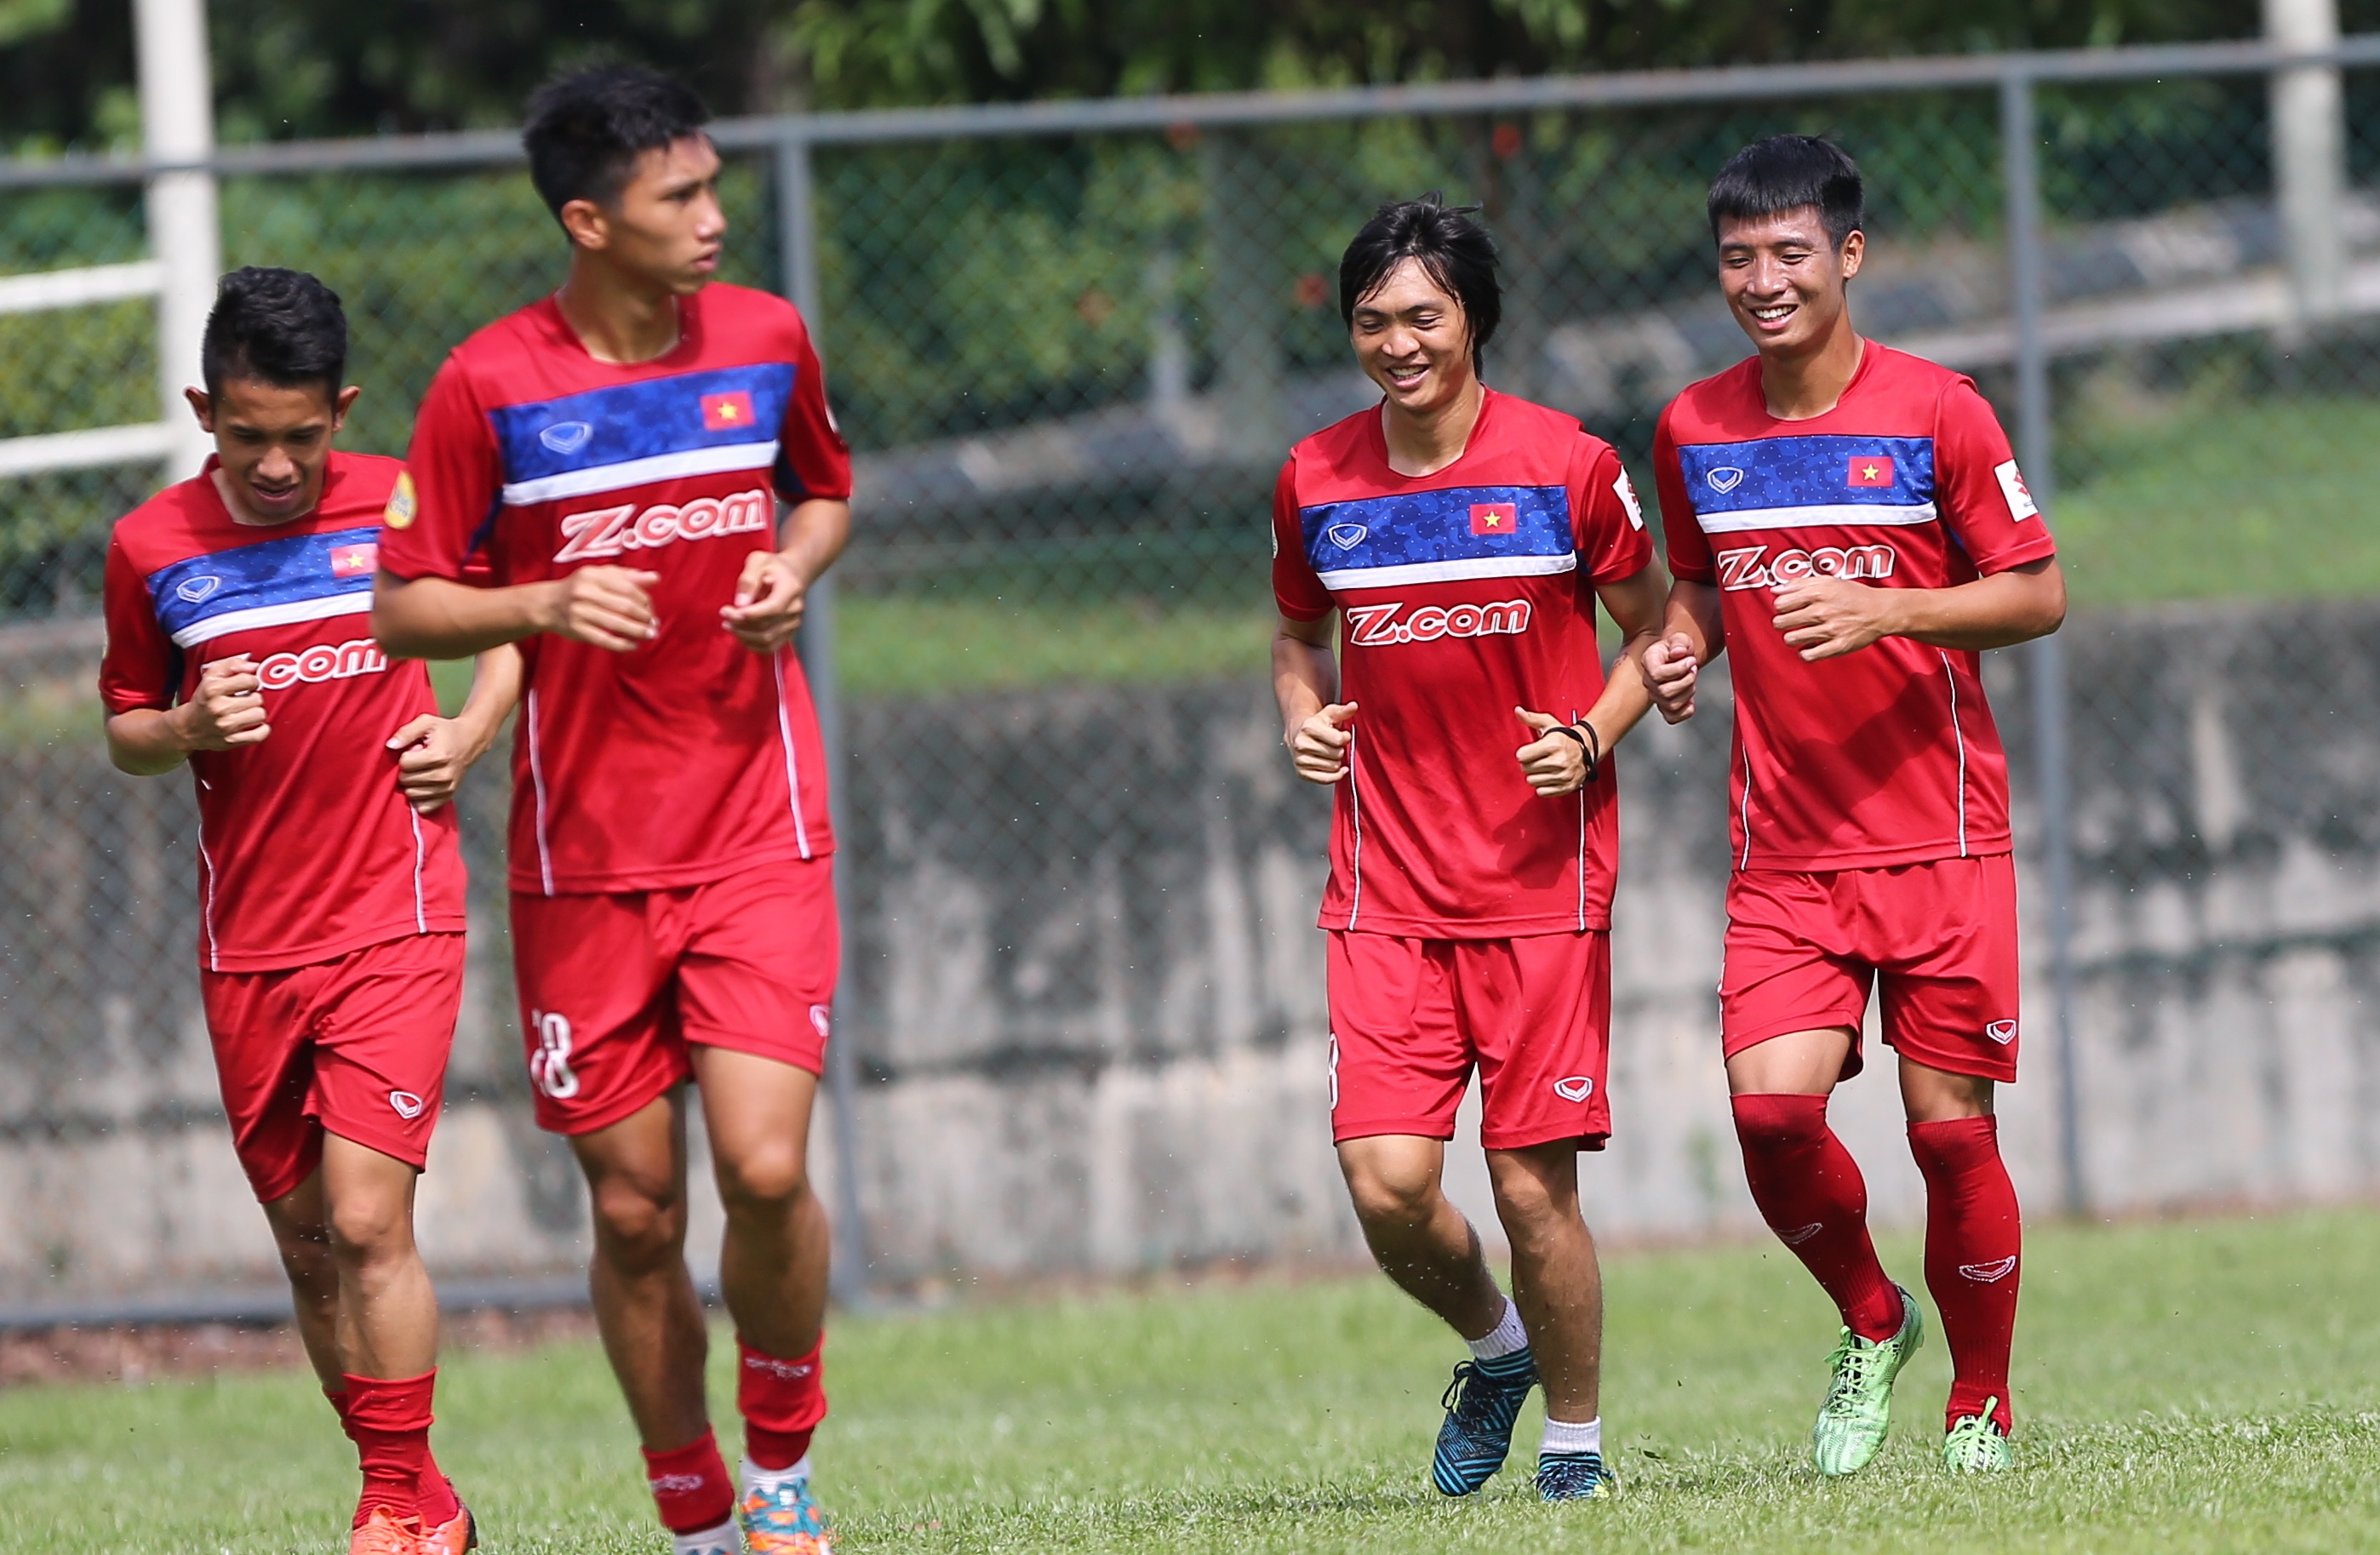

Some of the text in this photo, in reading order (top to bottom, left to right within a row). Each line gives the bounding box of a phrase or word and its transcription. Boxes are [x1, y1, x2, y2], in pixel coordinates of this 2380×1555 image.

[552, 489, 765, 563] Z.com
[1718, 545, 1895, 591] Z.com
[1347, 599, 1530, 645] Z.com
[201, 638, 387, 696] com
